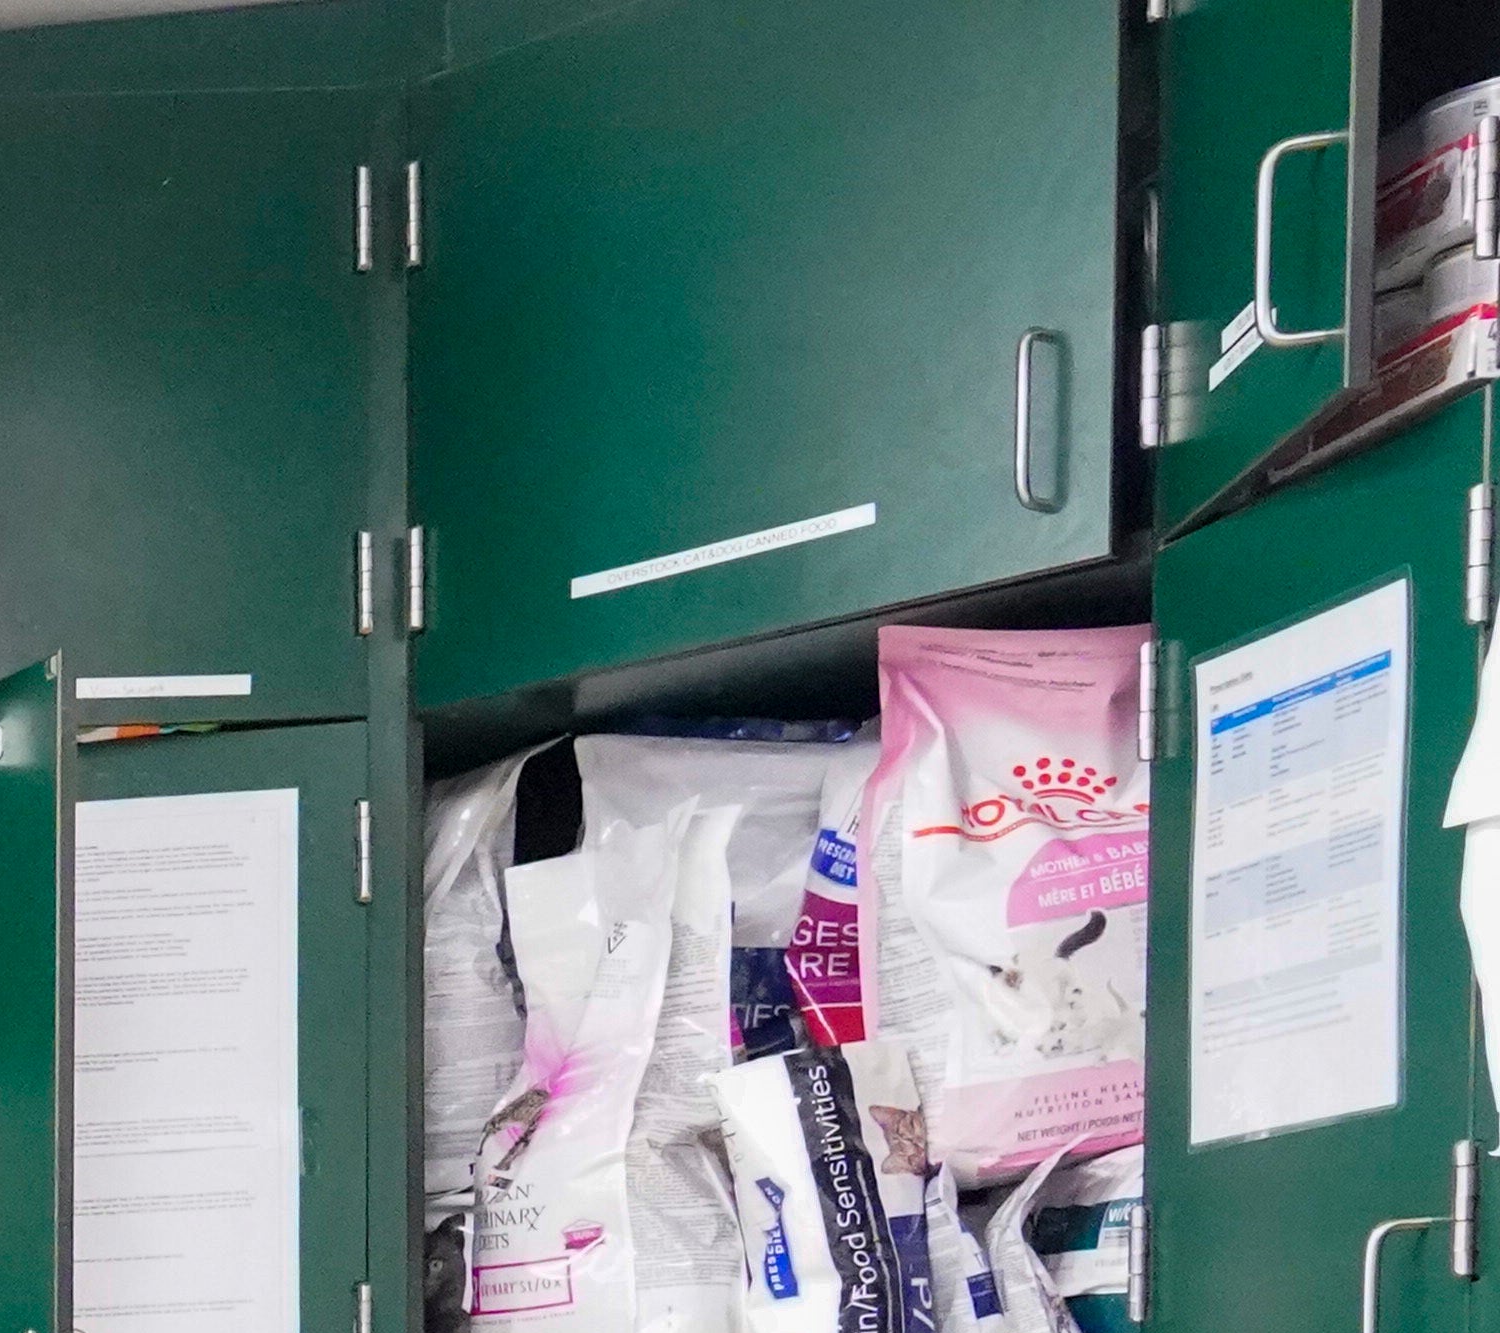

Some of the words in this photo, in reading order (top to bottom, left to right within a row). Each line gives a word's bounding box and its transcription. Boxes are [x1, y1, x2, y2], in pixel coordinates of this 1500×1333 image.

[744, 526, 798, 550] CANNED
[799, 517, 838, 536] FOOD
[1079, 882, 1096, 898] ET
[1099, 864, 1148, 895] BÉBÉ
[792, 914, 859, 948] GES
[800, 953, 852, 979] RE
[1100, 1080, 1141, 1095] HEAL
[1114, 1090, 1145, 1104] SAN
[808, 1064, 861, 1228] Sensitivities
